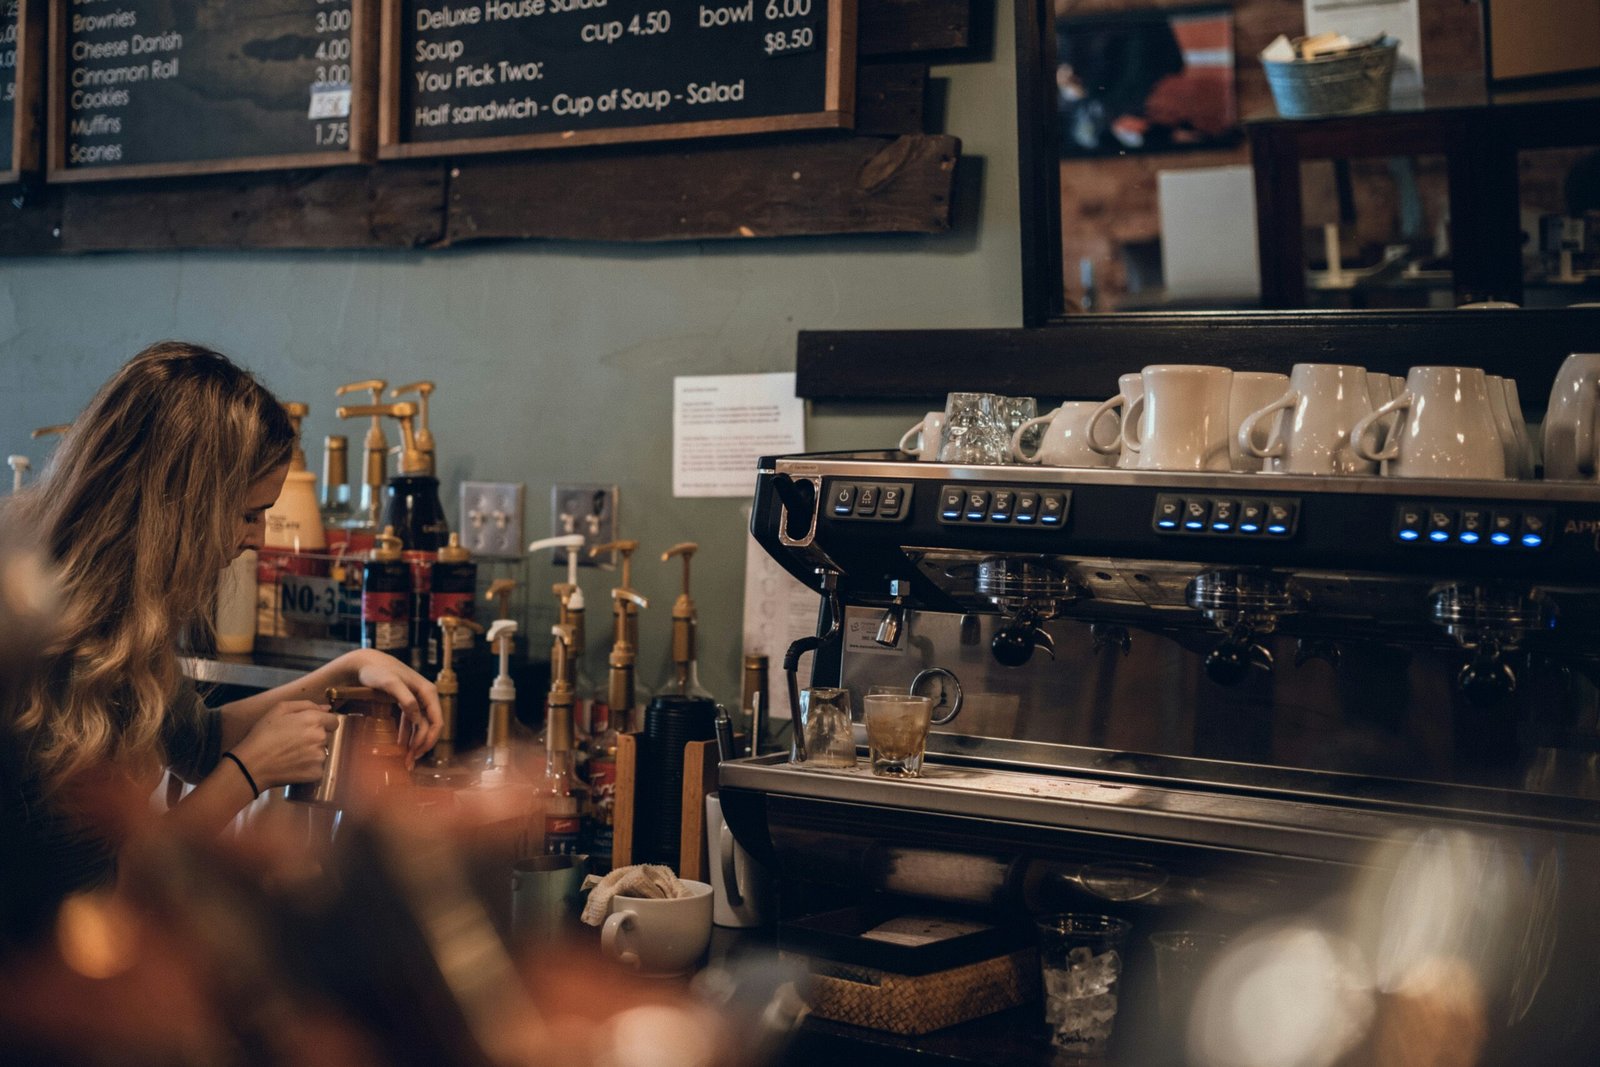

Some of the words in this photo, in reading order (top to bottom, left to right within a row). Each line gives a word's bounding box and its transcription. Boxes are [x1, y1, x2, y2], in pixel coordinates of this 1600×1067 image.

[72, 40, 129, 61] Cheese
[131, 30, 183, 55] Danish
[315, 9, 351, 33] 3.00
[73, 8, 136, 33] Brownies
[415, 39, 464, 62] Soup
[581, 19, 624, 44] cup
[627, 10, 671, 36] 4.50
[699, 0, 754, 28] bowl
[765, 0, 811, 20] 6.00
[416, 6, 481, 31] Deluxe
[485, 0, 545, 22] House
[72, 64, 149, 87] Cinnamon
[151, 57, 179, 80] Roll
[315, 38, 351, 61] 4.00
[415, 70, 452, 93] You
[455, 63, 496, 88] Pick
[498, 60, 544, 83] Two:
[763, 27, 813, 55] $8.50
[71, 87, 130, 110] Cookies
[315, 64, 350, 87] 3.00
[415, 103, 450, 127] Half
[452, 96, 538, 124] sandwich
[552, 93, 594, 117] Cup
[596, 89, 619, 112] of
[620, 88, 671, 112] Soup
[686, 79, 745, 105] Salad
[70, 143, 123, 163] Scones
[315, 122, 349, 145] 1.75
[71, 114, 122, 136] Muffins
